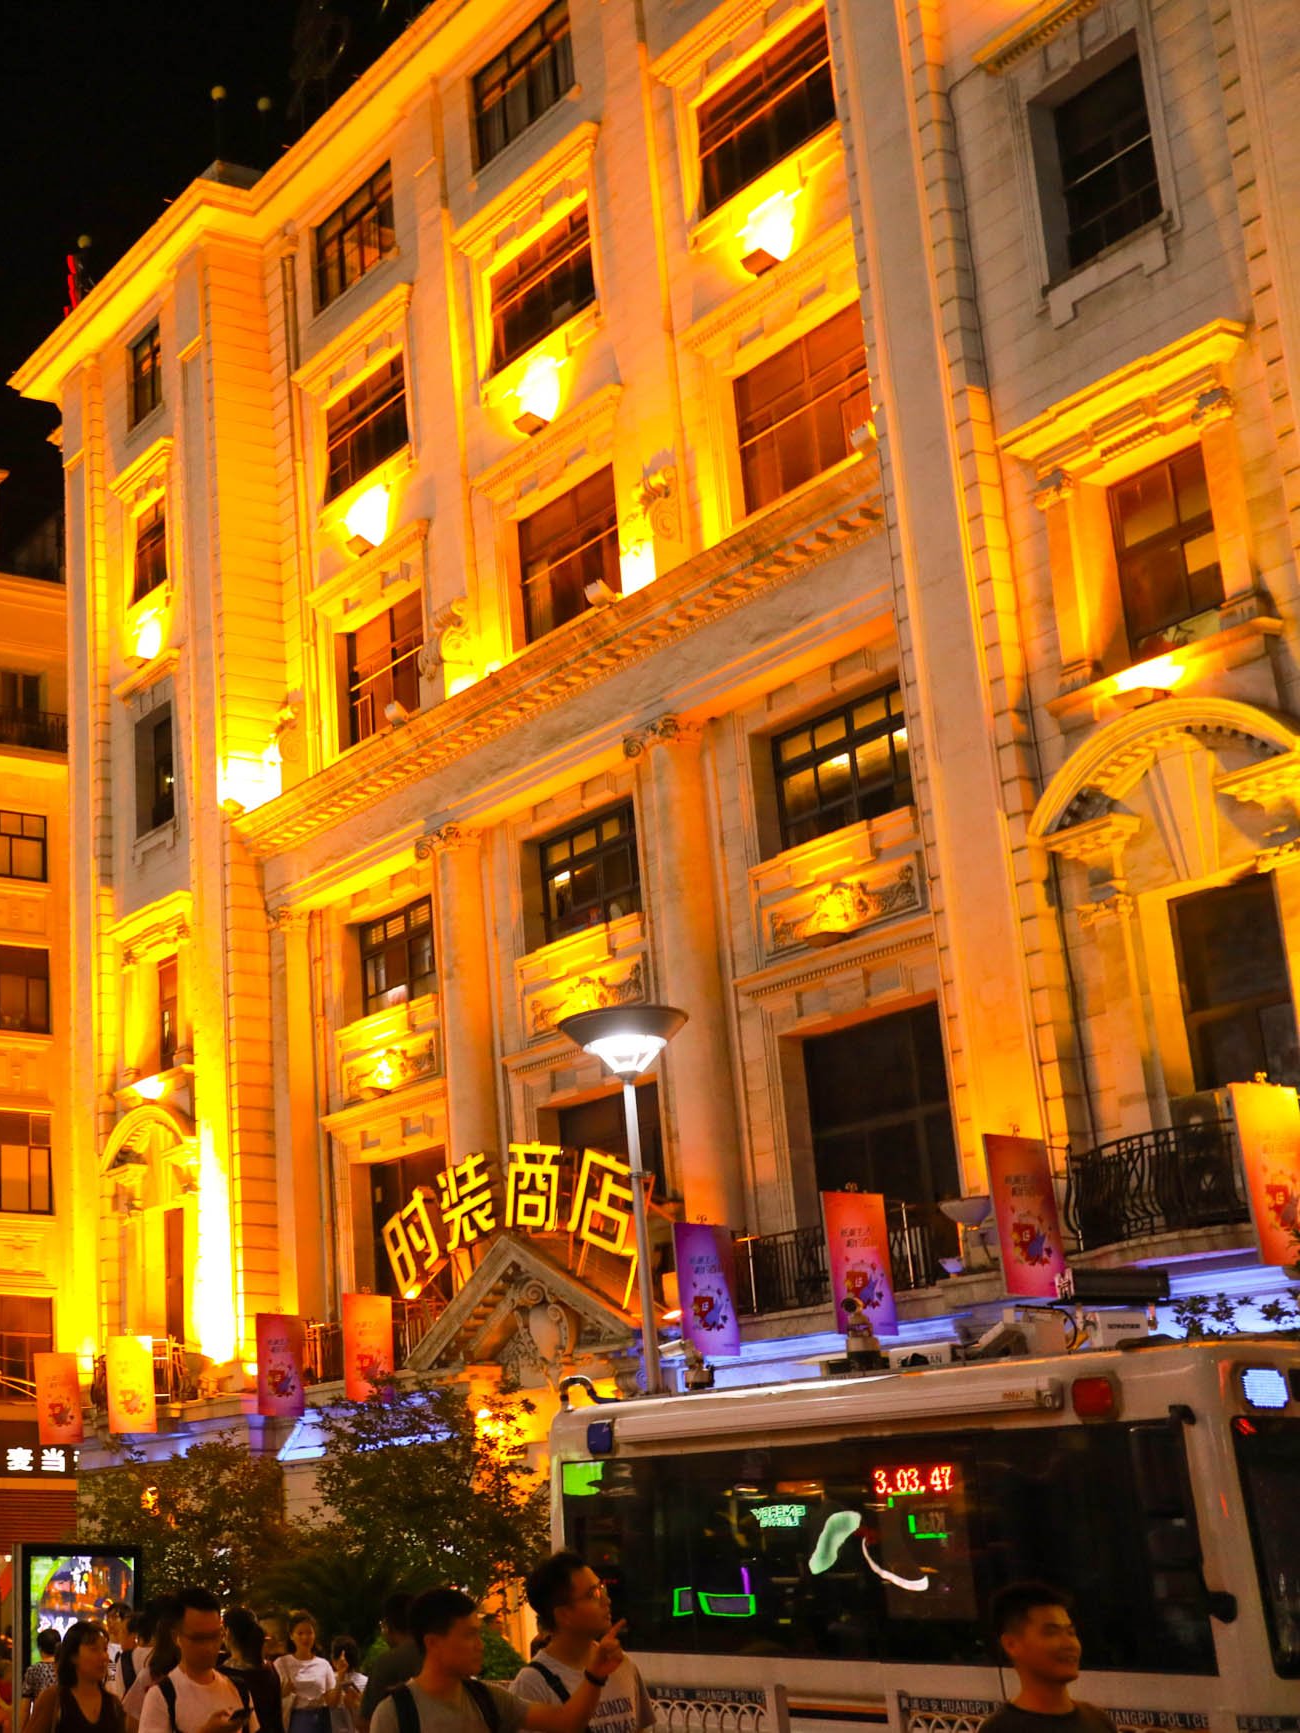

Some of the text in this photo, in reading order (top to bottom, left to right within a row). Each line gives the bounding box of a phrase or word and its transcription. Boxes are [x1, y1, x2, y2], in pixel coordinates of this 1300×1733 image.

[382, 1141, 634, 1298] 时装商店
[6, 1447, 80, 1472] 麦当
[941, 1701, 989, 1716] HUANGPU
[1159, 1713, 1210, 1730] POLICE
